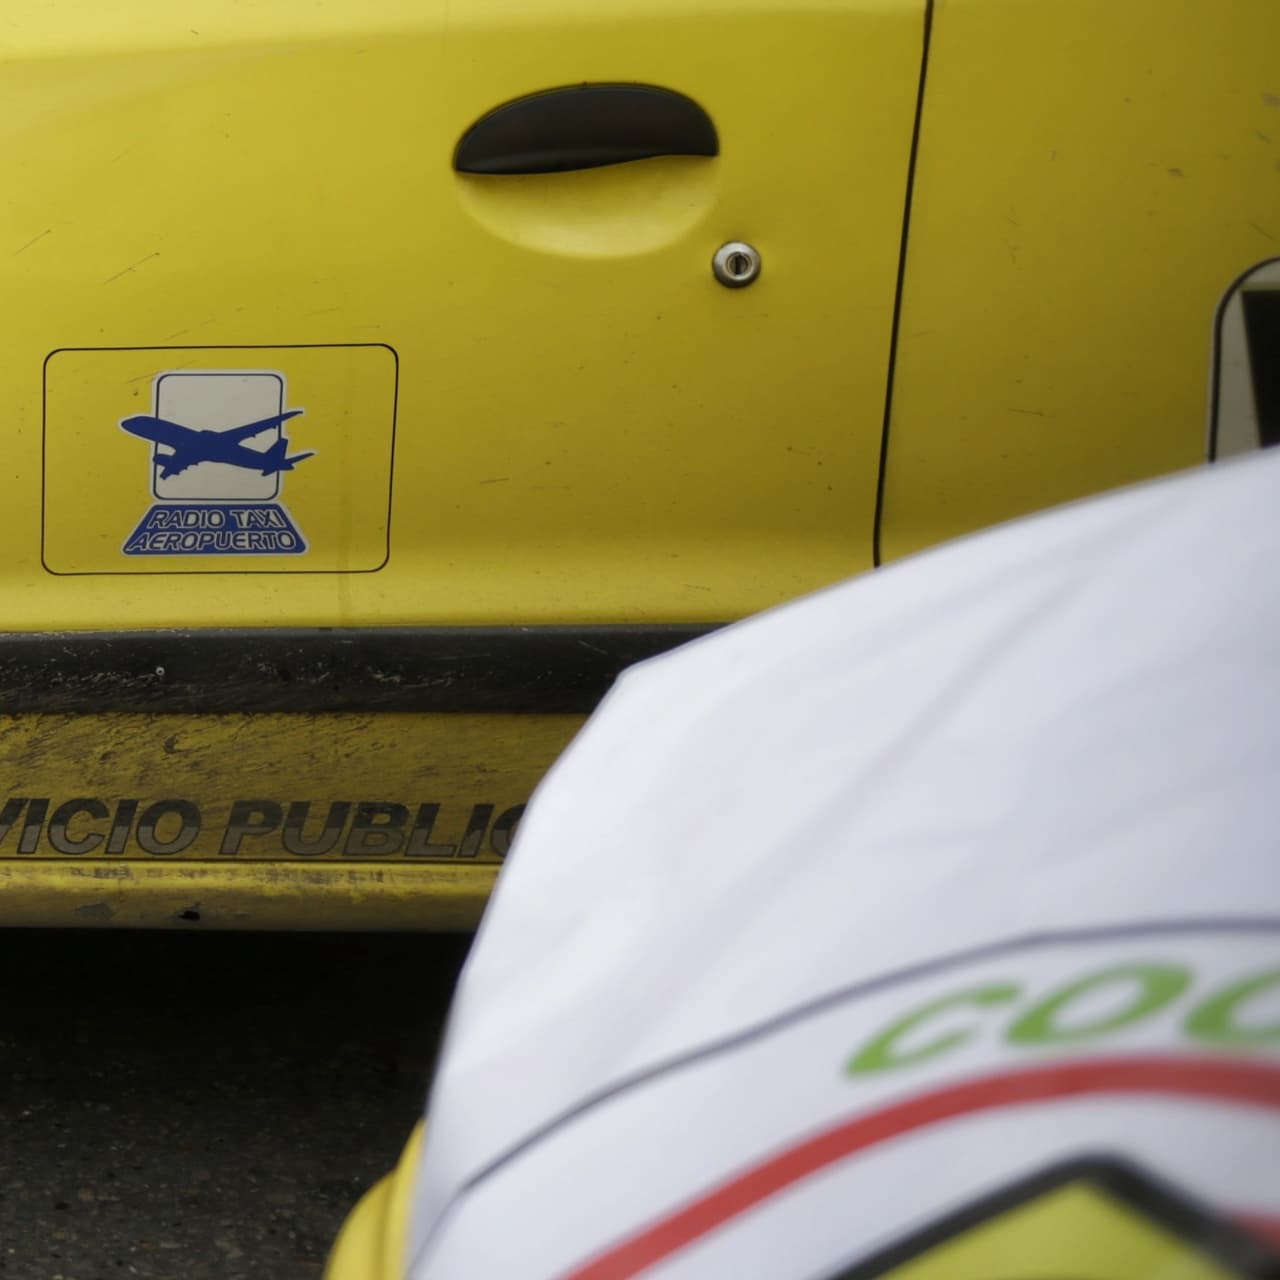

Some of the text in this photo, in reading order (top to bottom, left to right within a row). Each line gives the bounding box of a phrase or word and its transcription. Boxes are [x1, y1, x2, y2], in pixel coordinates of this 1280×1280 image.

[148, 510, 286, 529] RADIO TAXI
[128, 532, 296, 551] AEROPUERTO
